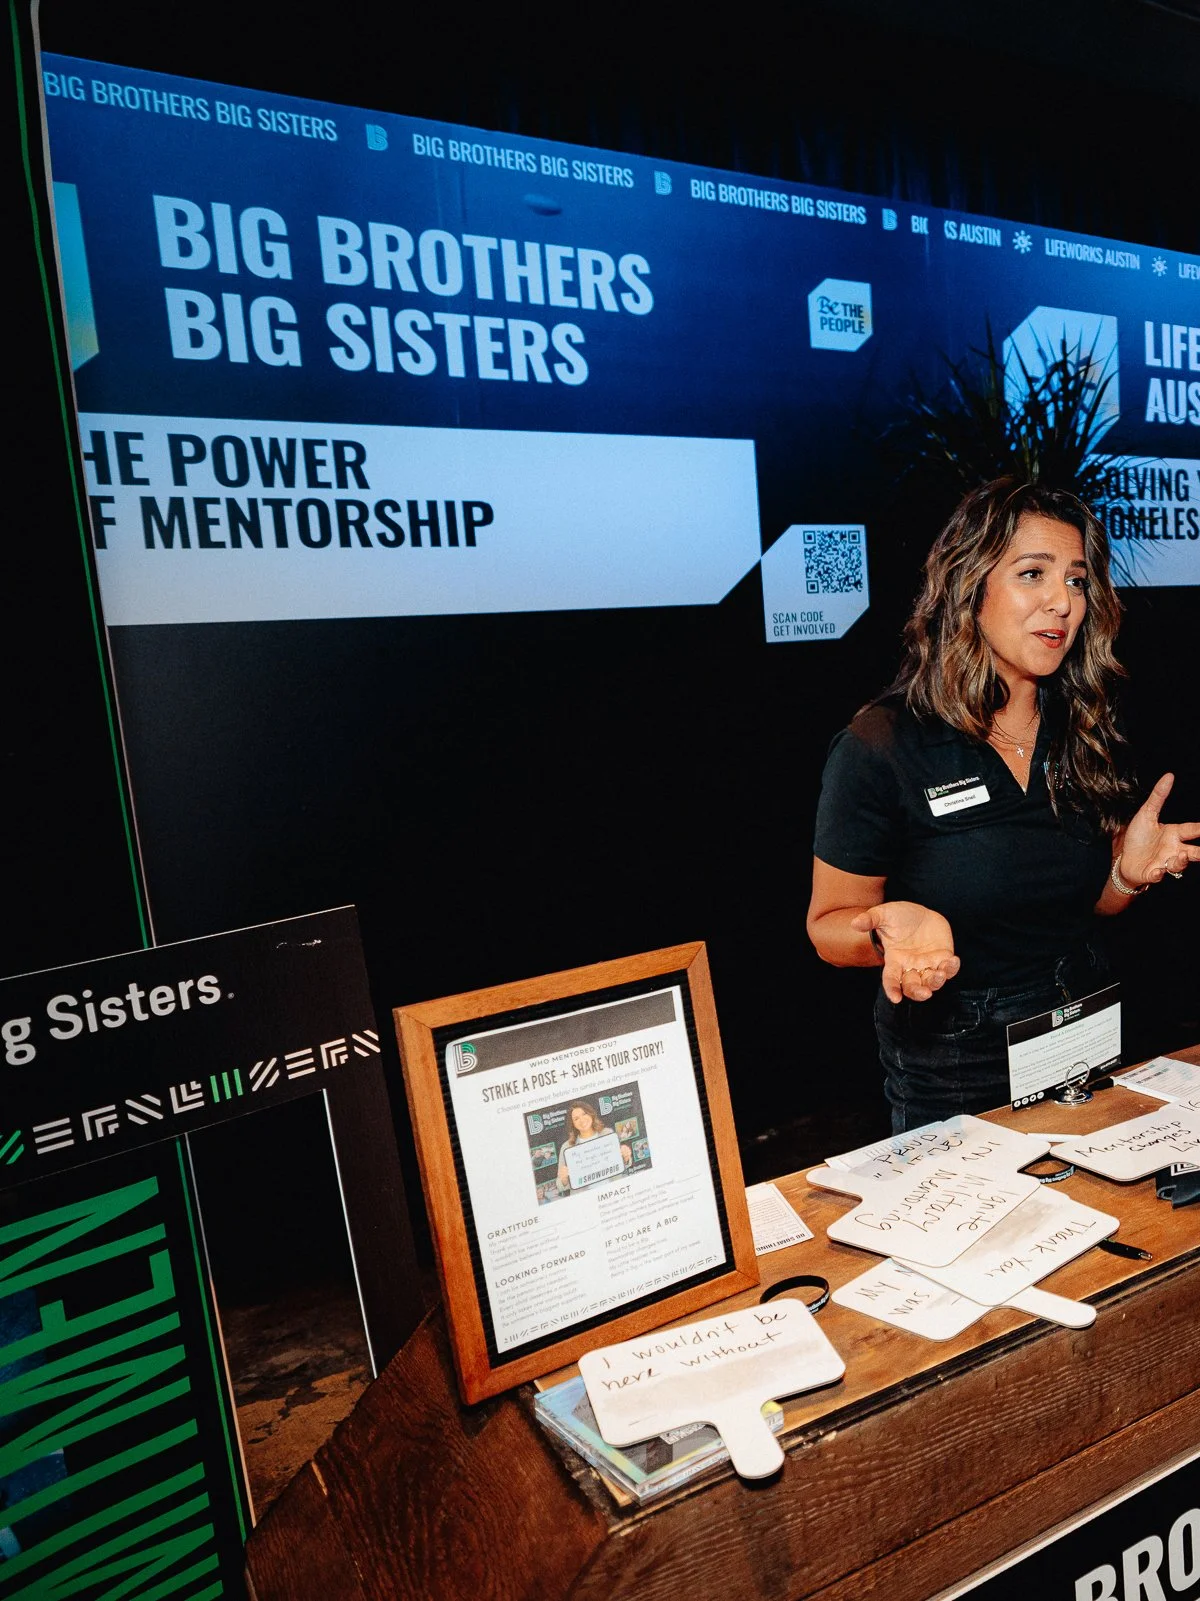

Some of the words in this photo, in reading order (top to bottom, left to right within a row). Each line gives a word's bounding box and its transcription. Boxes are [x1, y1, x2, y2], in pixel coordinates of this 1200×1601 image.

[42, 71, 86, 101] BIG
[91, 79, 210, 122] BROTHERS
[214, 101, 252, 128] BIG
[257, 108, 338, 142] SISTERS
[412, 133, 444, 159] BIG
[449, 139, 537, 174] BROTHERS
[541, 154, 569, 179] BIG
[572, 159, 634, 188] SISTERS
[690, 178, 716, 201] BIG
[718, 183, 790, 214] BROTHERS
[791, 195, 815, 217] BIG
[816, 199, 867, 225] SISTERS
[959, 222, 1002, 248] AUSTIN
[1045, 238, 1104, 265] LIFEWORKS
[1105, 250, 1140, 270] AUSTIN
[152, 194, 293, 280] BIG
[316, 214, 655, 316] BROTHERS
[820, 316, 865, 334] PEOPLE
[841, 302, 865, 319] THE
[164, 287, 302, 368] BIG
[326, 302, 590, 386] SISTERS
[166, 433, 371, 490] POWER
[1102, 466, 1190, 502] OLVING
[140, 495, 495, 550] MENTORSHIP
[772, 611, 797, 624] SCAN
[800, 610, 824, 622] CODE
[773, 624, 791, 637] GET
[793, 622, 836, 636] INVOLVED
[482, 1079, 520, 1103] STRIKE
[522, 1078, 530, 1092] A
[531, 1070, 558, 1091] POSE
[571, 1058, 604, 1079] SHARE
[605, 1051, 632, 1070] YOUR
[632, 1041, 666, 1062] STORY!
[529, 1058, 550, 1069] WHO
[552, 1047, 595, 1063] MENTORED
[597, 1041, 617, 1053] YOU?
[1074, 1120, 1181, 1158] Mentorship
[578, 1164, 620, 1186] #SHOWUPBIG
[597, 1185, 631, 1202] IMPACT
[854, 1168, 958, 1231] Mentoring
[903, 1173, 995, 1233] Military
[957, 1192, 1020, 1231] Ignite
[487, 1216, 541, 1240] GRATITUDE
[604, 1239, 612, 1249] IF
[615, 1231, 634, 1243] YOU
[636, 1225, 651, 1237] ARE
[656, 1221, 662, 1229] A
[664, 1215, 679, 1226] BIG
[1031, 1219, 1097, 1254] Thank
[495, 1267, 538, 1289] LOOKING
[540, 1250, 587, 1272] FORWARD
[602, 1356, 610, 1369] I
[632, 1320, 738, 1361] wouldn't
[754, 1310, 788, 1327] be
[602, 1367, 661, 1391] here
[679, 1331, 782, 1368] without
